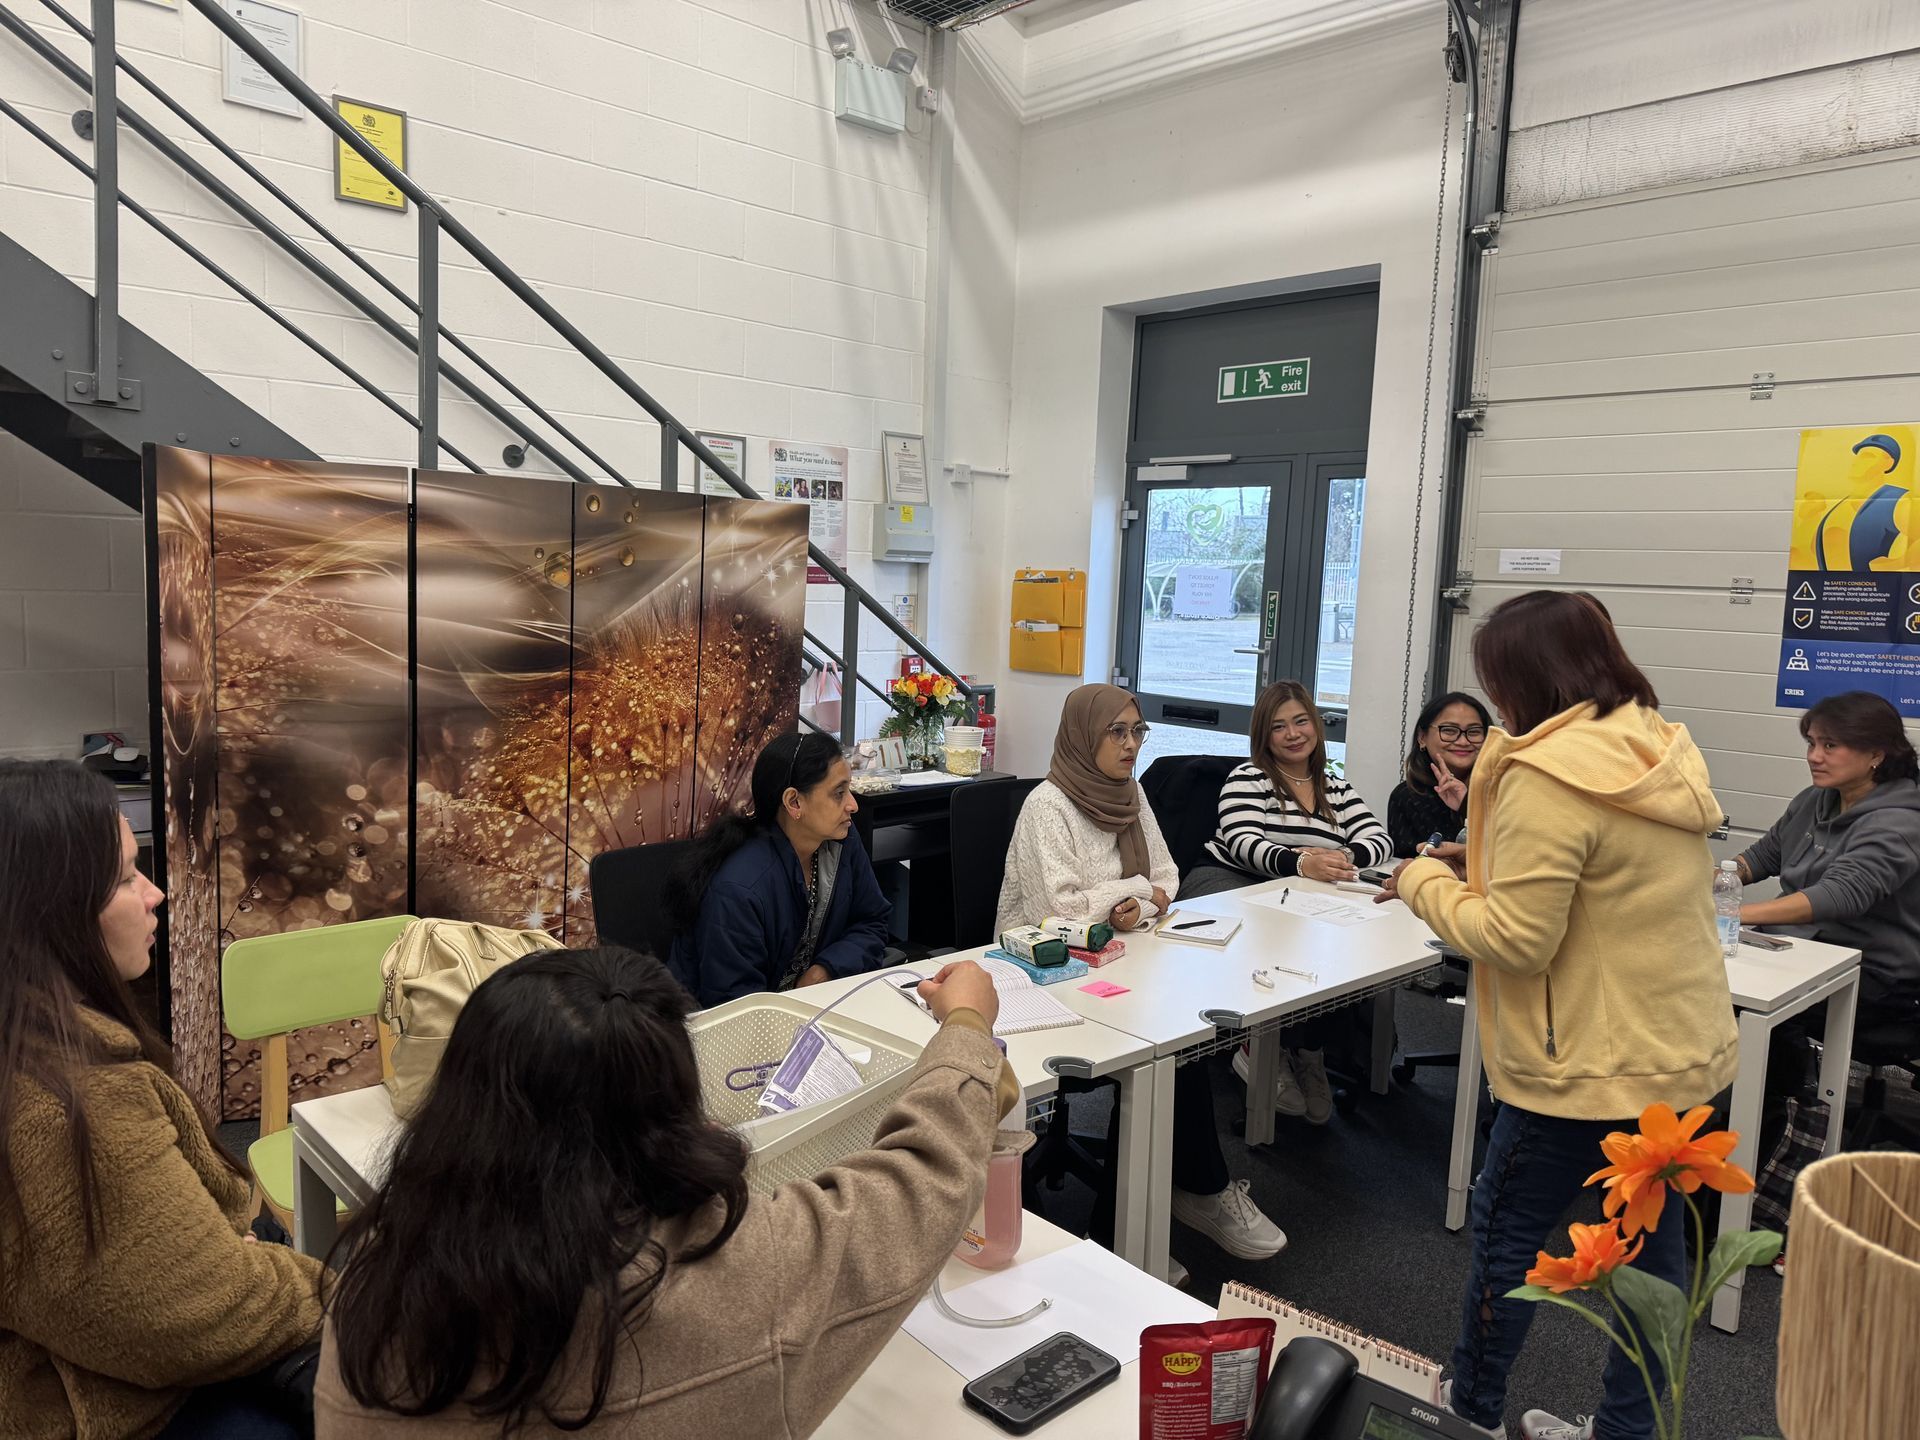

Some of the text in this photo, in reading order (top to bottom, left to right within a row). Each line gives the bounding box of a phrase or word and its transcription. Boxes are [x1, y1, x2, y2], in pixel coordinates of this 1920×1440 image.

[1282, 365, 1303, 377] Fire
[1281, 380, 1301, 392] exit
[1164, 1357, 1200, 1366] HAPPY
[1410, 1407, 1439, 1425] snom
